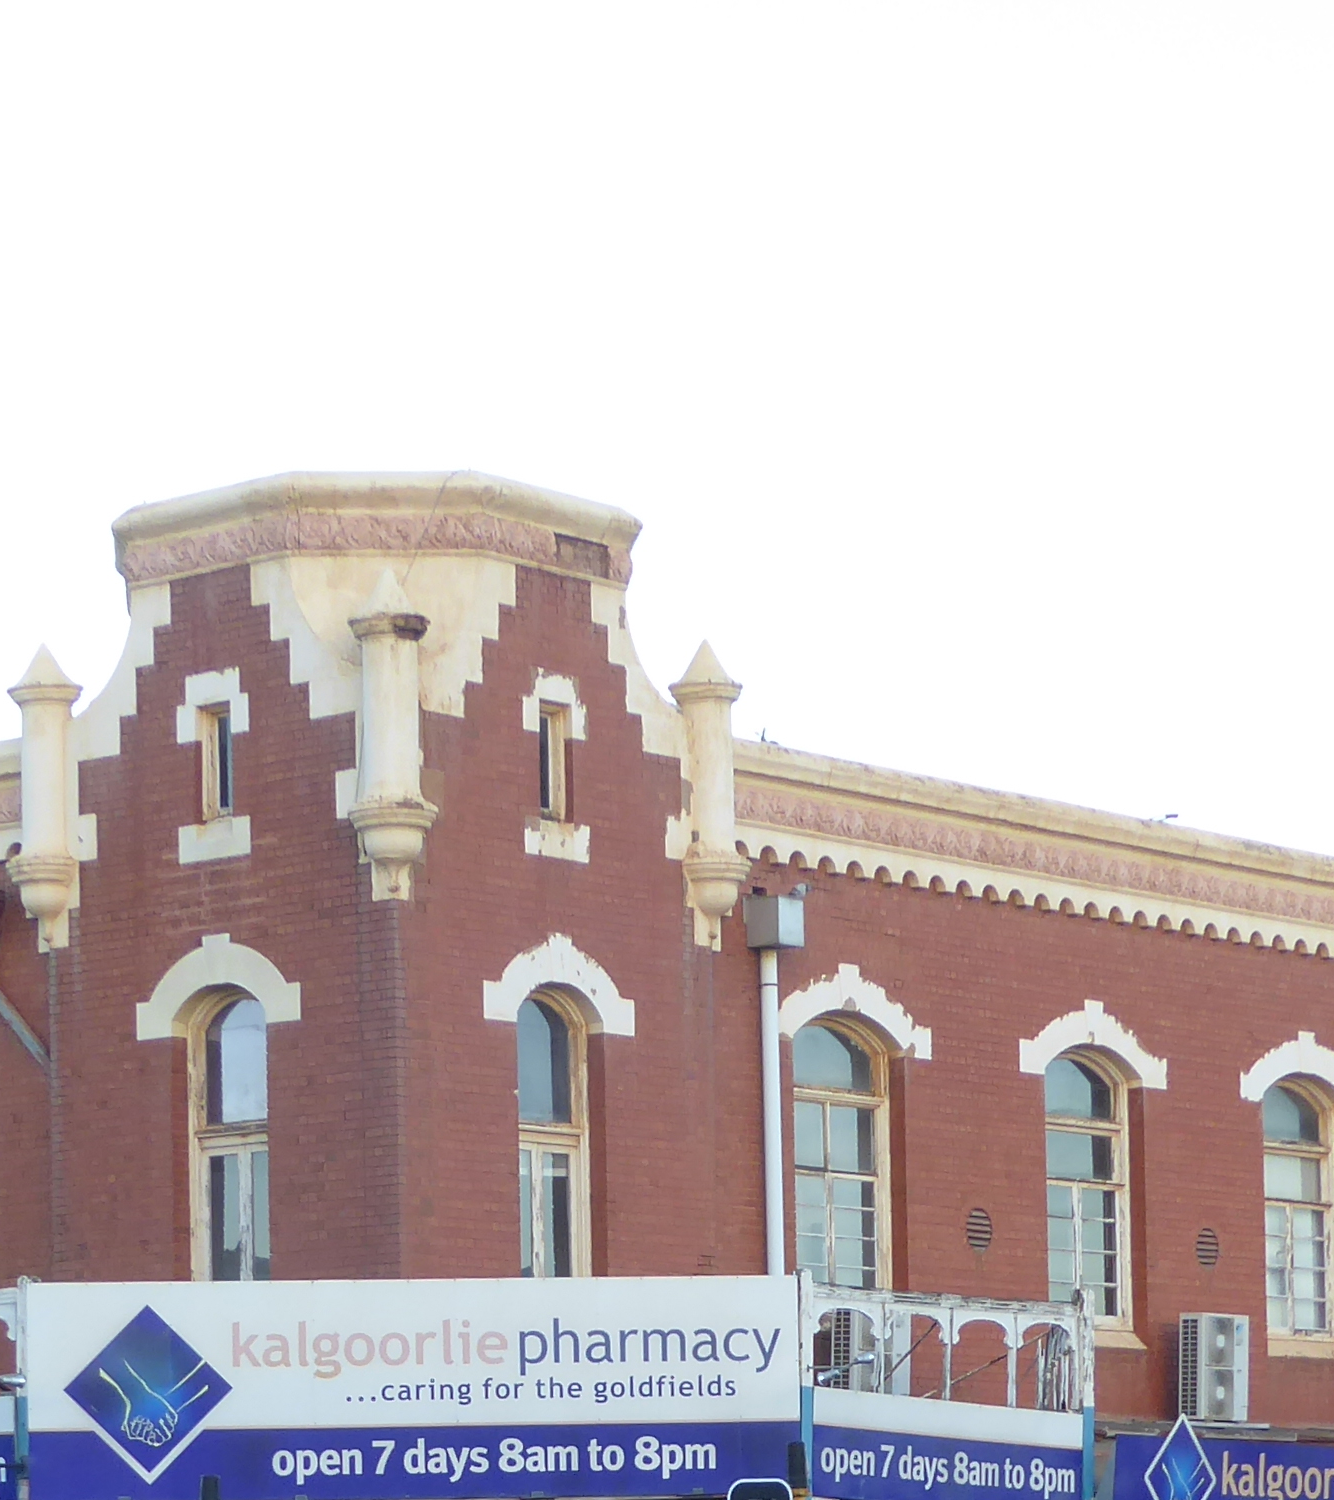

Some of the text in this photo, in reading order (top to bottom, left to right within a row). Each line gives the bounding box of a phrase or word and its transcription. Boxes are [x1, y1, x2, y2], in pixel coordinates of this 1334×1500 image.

[231, 1317, 781, 1379] kalgoorlie pharmacy
[482, 1377, 524, 1400] for
[536, 1376, 583, 1399] the
[594, 1374, 737, 1404] goldfields
[272, 1436, 717, 1485] open 7 days 8am to 8pm
[820, 1444, 1076, 1500] open 7 days 8am to 8pm
